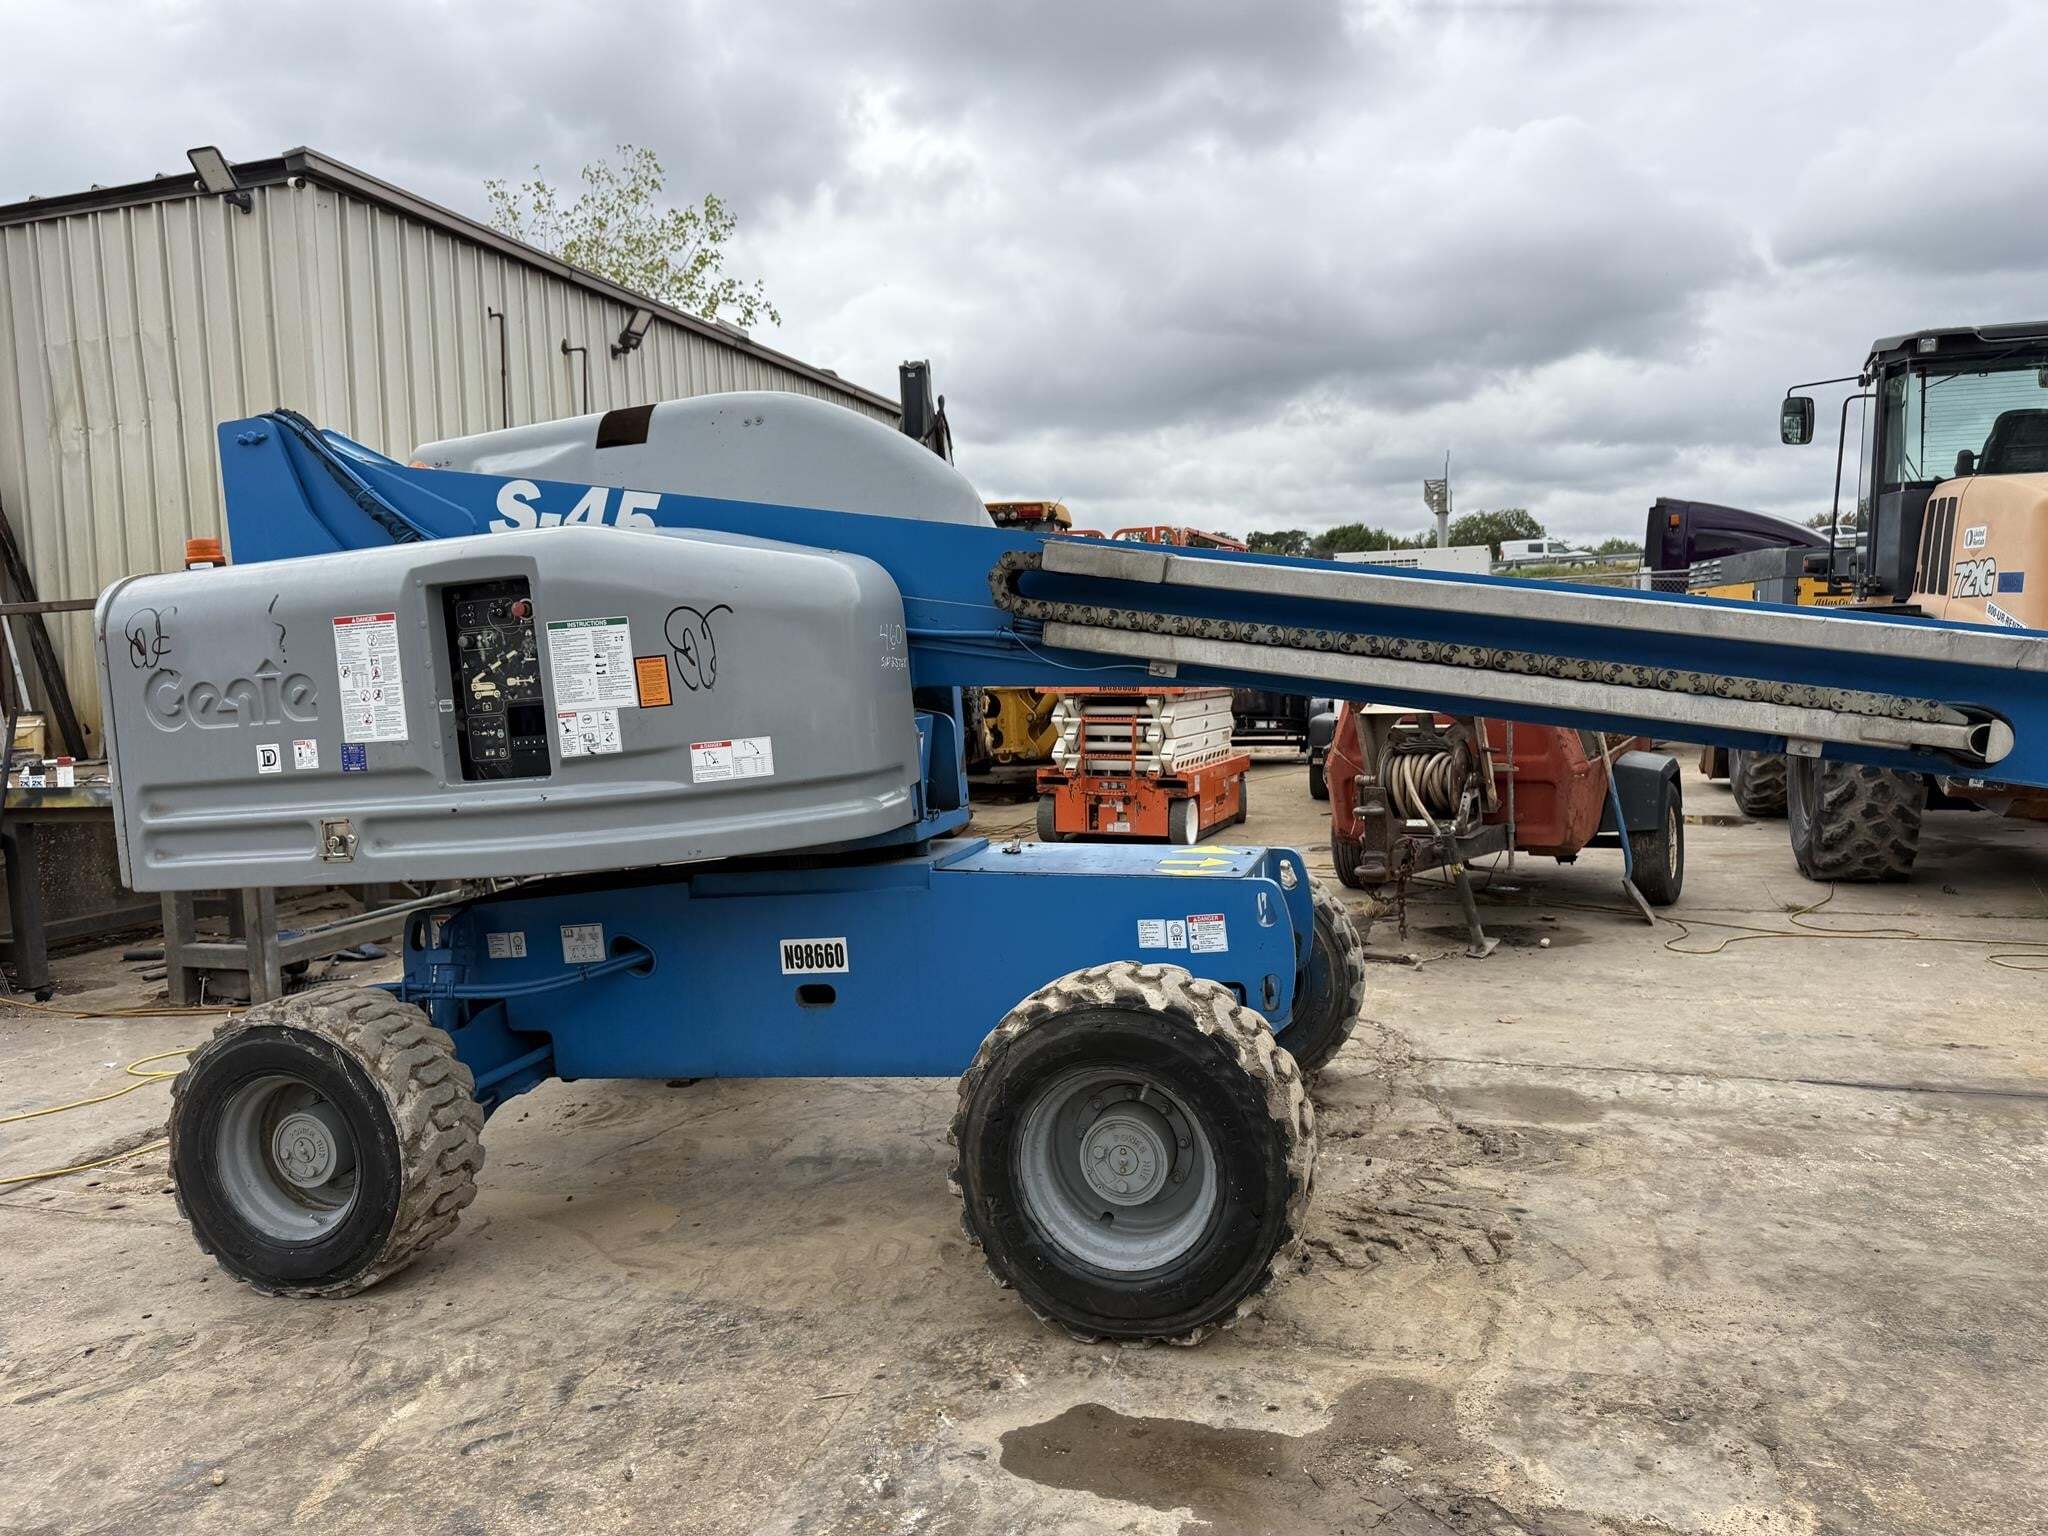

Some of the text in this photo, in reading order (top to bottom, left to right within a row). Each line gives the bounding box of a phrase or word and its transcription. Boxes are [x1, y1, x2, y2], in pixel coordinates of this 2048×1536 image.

[489, 479, 662, 534] S-45
[1952, 557, 1997, 599] 721G
[566, 619, 608, 628] INSTRUCTIONS
[145, 658, 319, 733] Genie
[261, 748, 277, 767] D
[1197, 915, 1219, 923] DANGER
[783, 942, 845, 970] N98660
